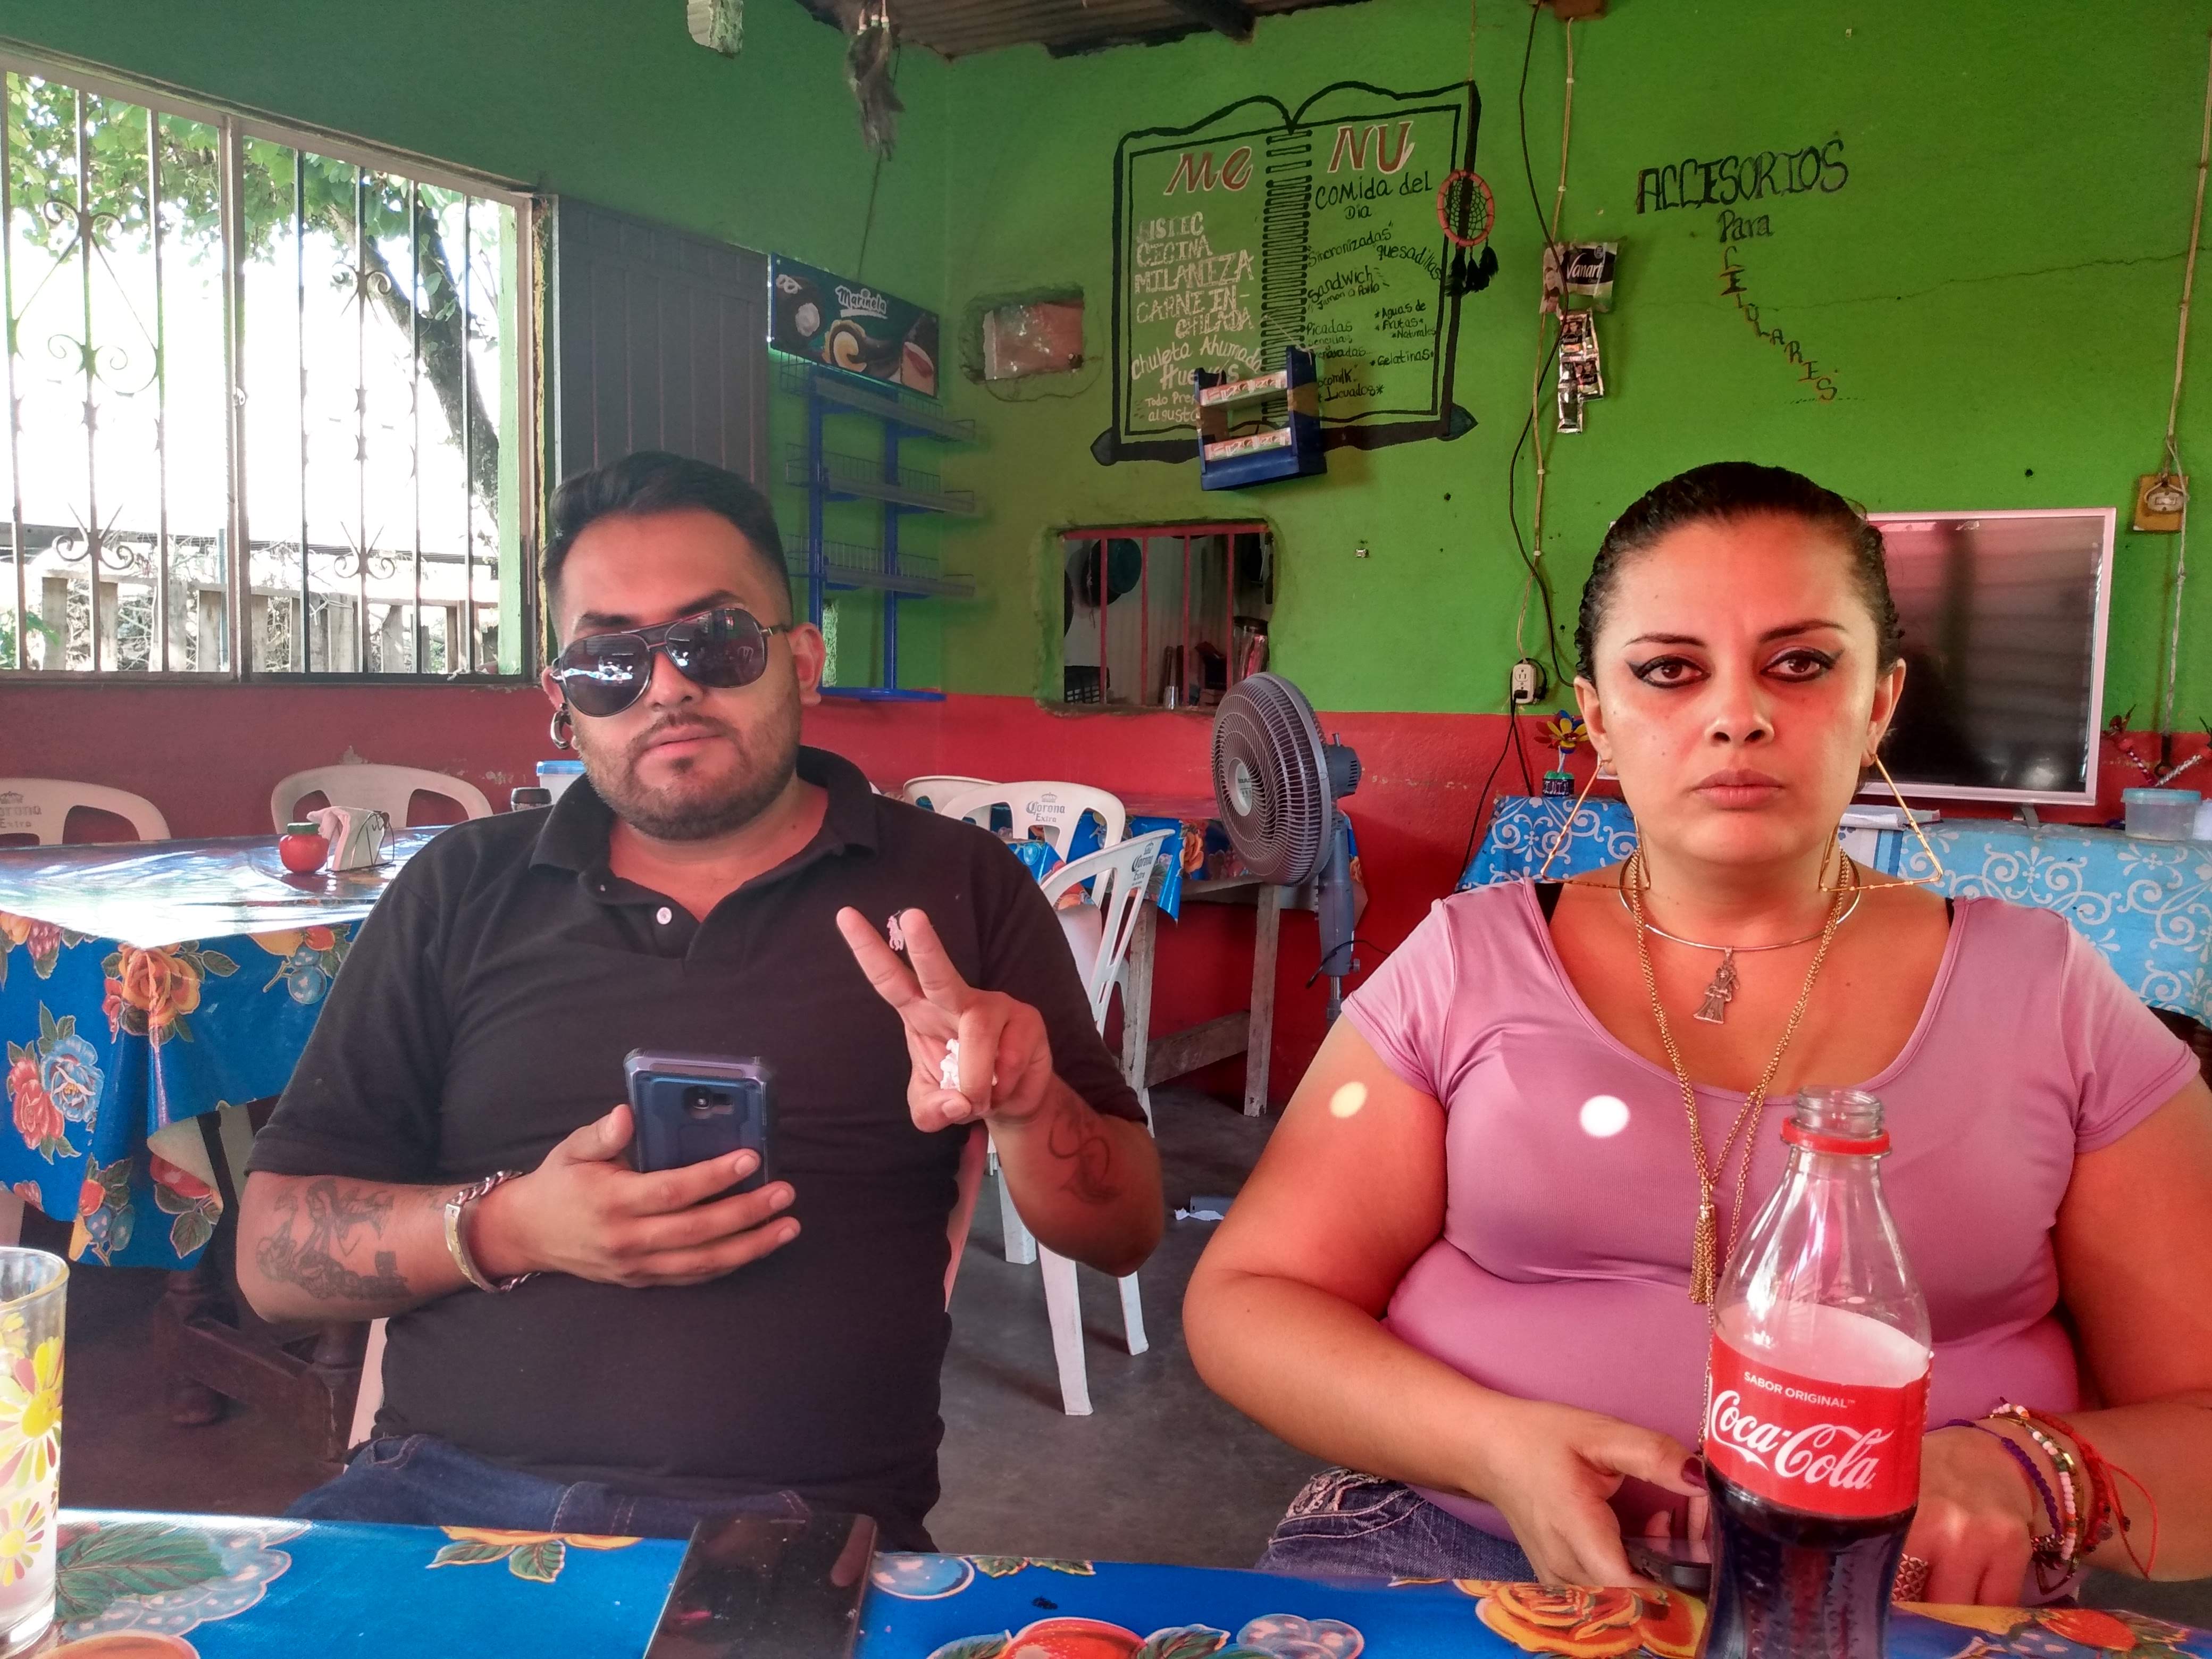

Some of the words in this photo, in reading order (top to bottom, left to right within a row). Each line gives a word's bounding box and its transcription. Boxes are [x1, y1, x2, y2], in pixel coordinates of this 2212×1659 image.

[1400, 171, 1432, 195] del
[1637, 139, 1848, 214] ACCESORIOS
[1718, 210, 1774, 243] Para
[1136, 234, 1213, 267] CECINA
[1134, 249, 1254, 294] MILANEZA
[1566, 253, 1604, 279] Vanart
[835, 286, 887, 315] Marinela
[1136, 290, 1205, 323] CARNE
[1415, 299, 1426, 312] de
[1175, 307, 1254, 339] CHILADA
[1306, 319, 1352, 336] Picadas
[1132, 341, 1192, 380] Chuleta
[1145, 393, 1168, 407] Todo
[1026, 800, 1065, 815] Corona
[1035, 813, 1057, 822] Extra
[1132, 854, 1153, 872] Corona
[1744, 1371, 1783, 1394] SABOR
[1711, 1390, 1895, 1489] Coca-Cola
